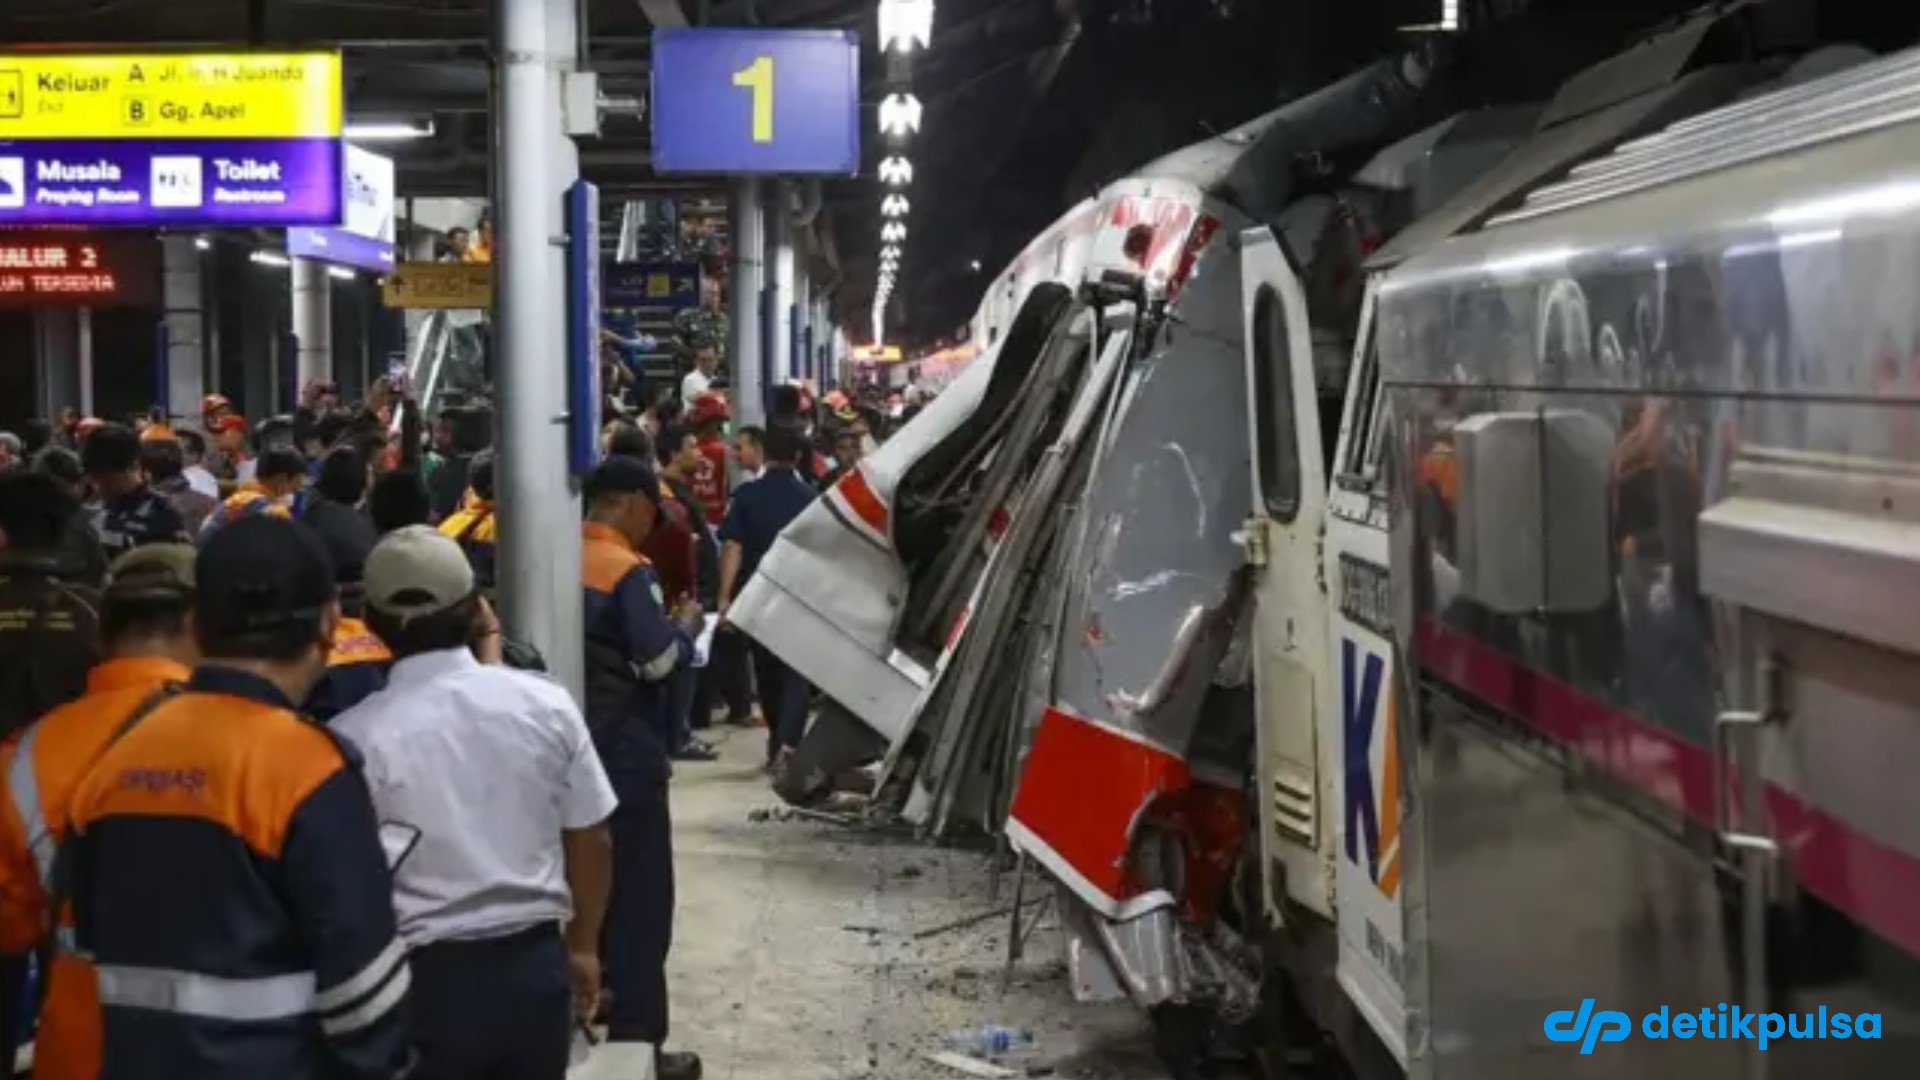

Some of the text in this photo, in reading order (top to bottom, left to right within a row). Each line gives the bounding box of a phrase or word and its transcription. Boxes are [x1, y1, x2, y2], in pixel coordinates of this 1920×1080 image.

[37, 72, 110, 92] Keluar
[128, 63, 146, 82] A
[732, 56, 773, 143] 1
[129, 99, 245, 122] B Gg. Apel
[37, 160, 121, 181] Musala
[214, 159, 281, 180] Toilet
[81, 247, 97, 268] 2
